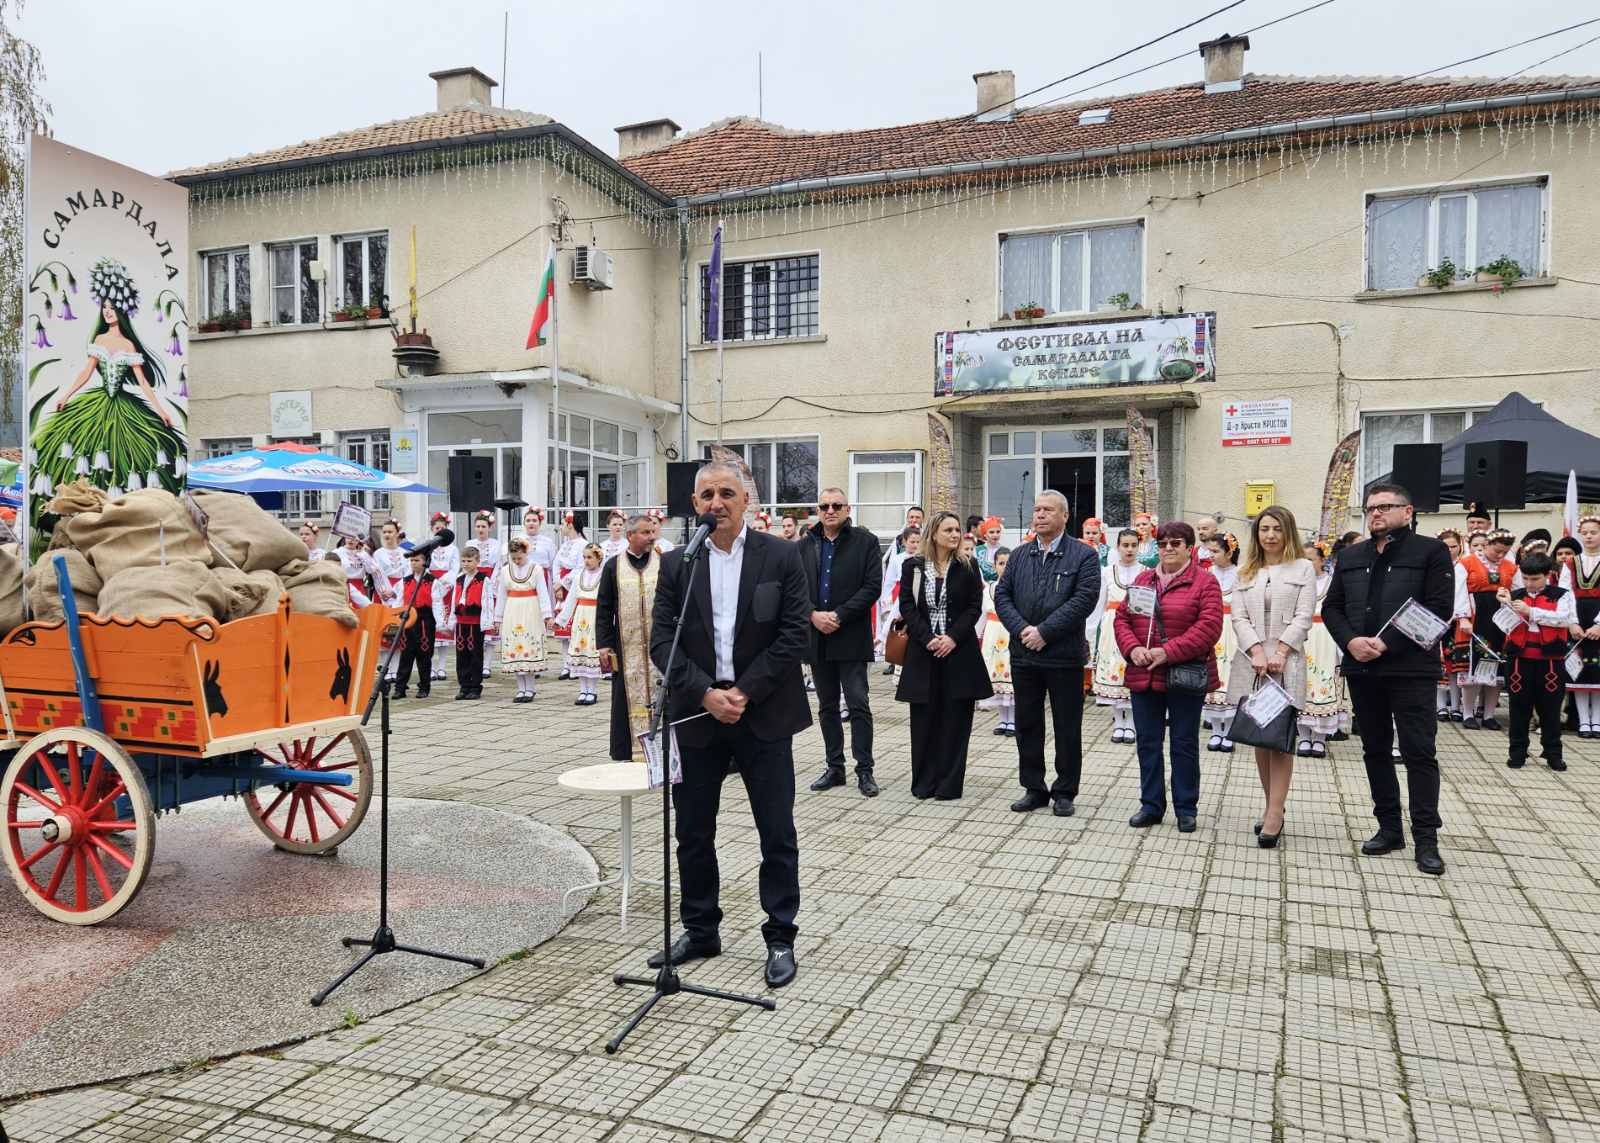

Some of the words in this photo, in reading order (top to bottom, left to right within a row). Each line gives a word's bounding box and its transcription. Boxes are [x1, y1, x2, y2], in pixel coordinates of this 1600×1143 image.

[43, 188, 179, 281] САМАРДАЛА
[997, 328, 1110, 351] ФЕСТИВАЛ
[1115, 328, 1145, 344] НА
[1012, 348, 1132, 367] САМАРДАЛАТА
